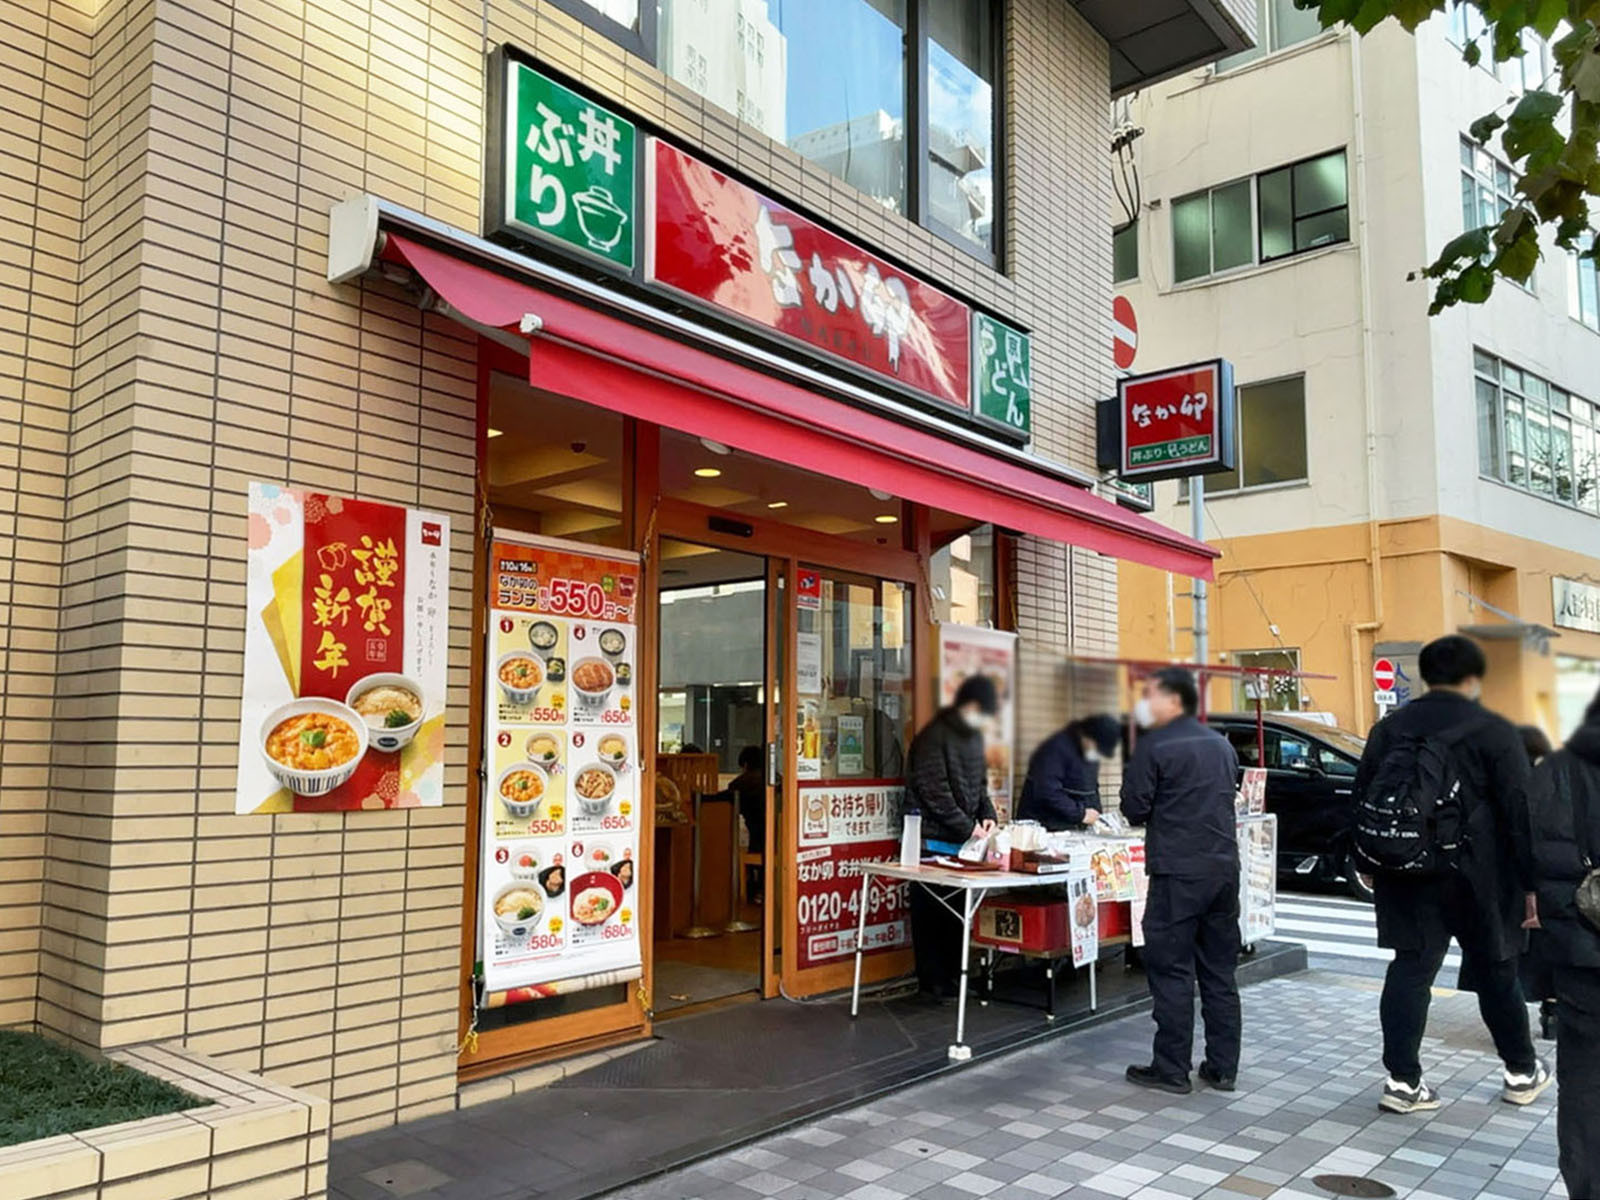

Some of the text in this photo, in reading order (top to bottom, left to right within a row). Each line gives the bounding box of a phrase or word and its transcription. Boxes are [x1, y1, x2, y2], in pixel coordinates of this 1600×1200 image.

[979, 320, 1024, 427] うどん
[311, 573, 352, 680] 新年
[350, 534, 401, 637] 謹賀
[831, 793, 885, 818] お持ち帰り
